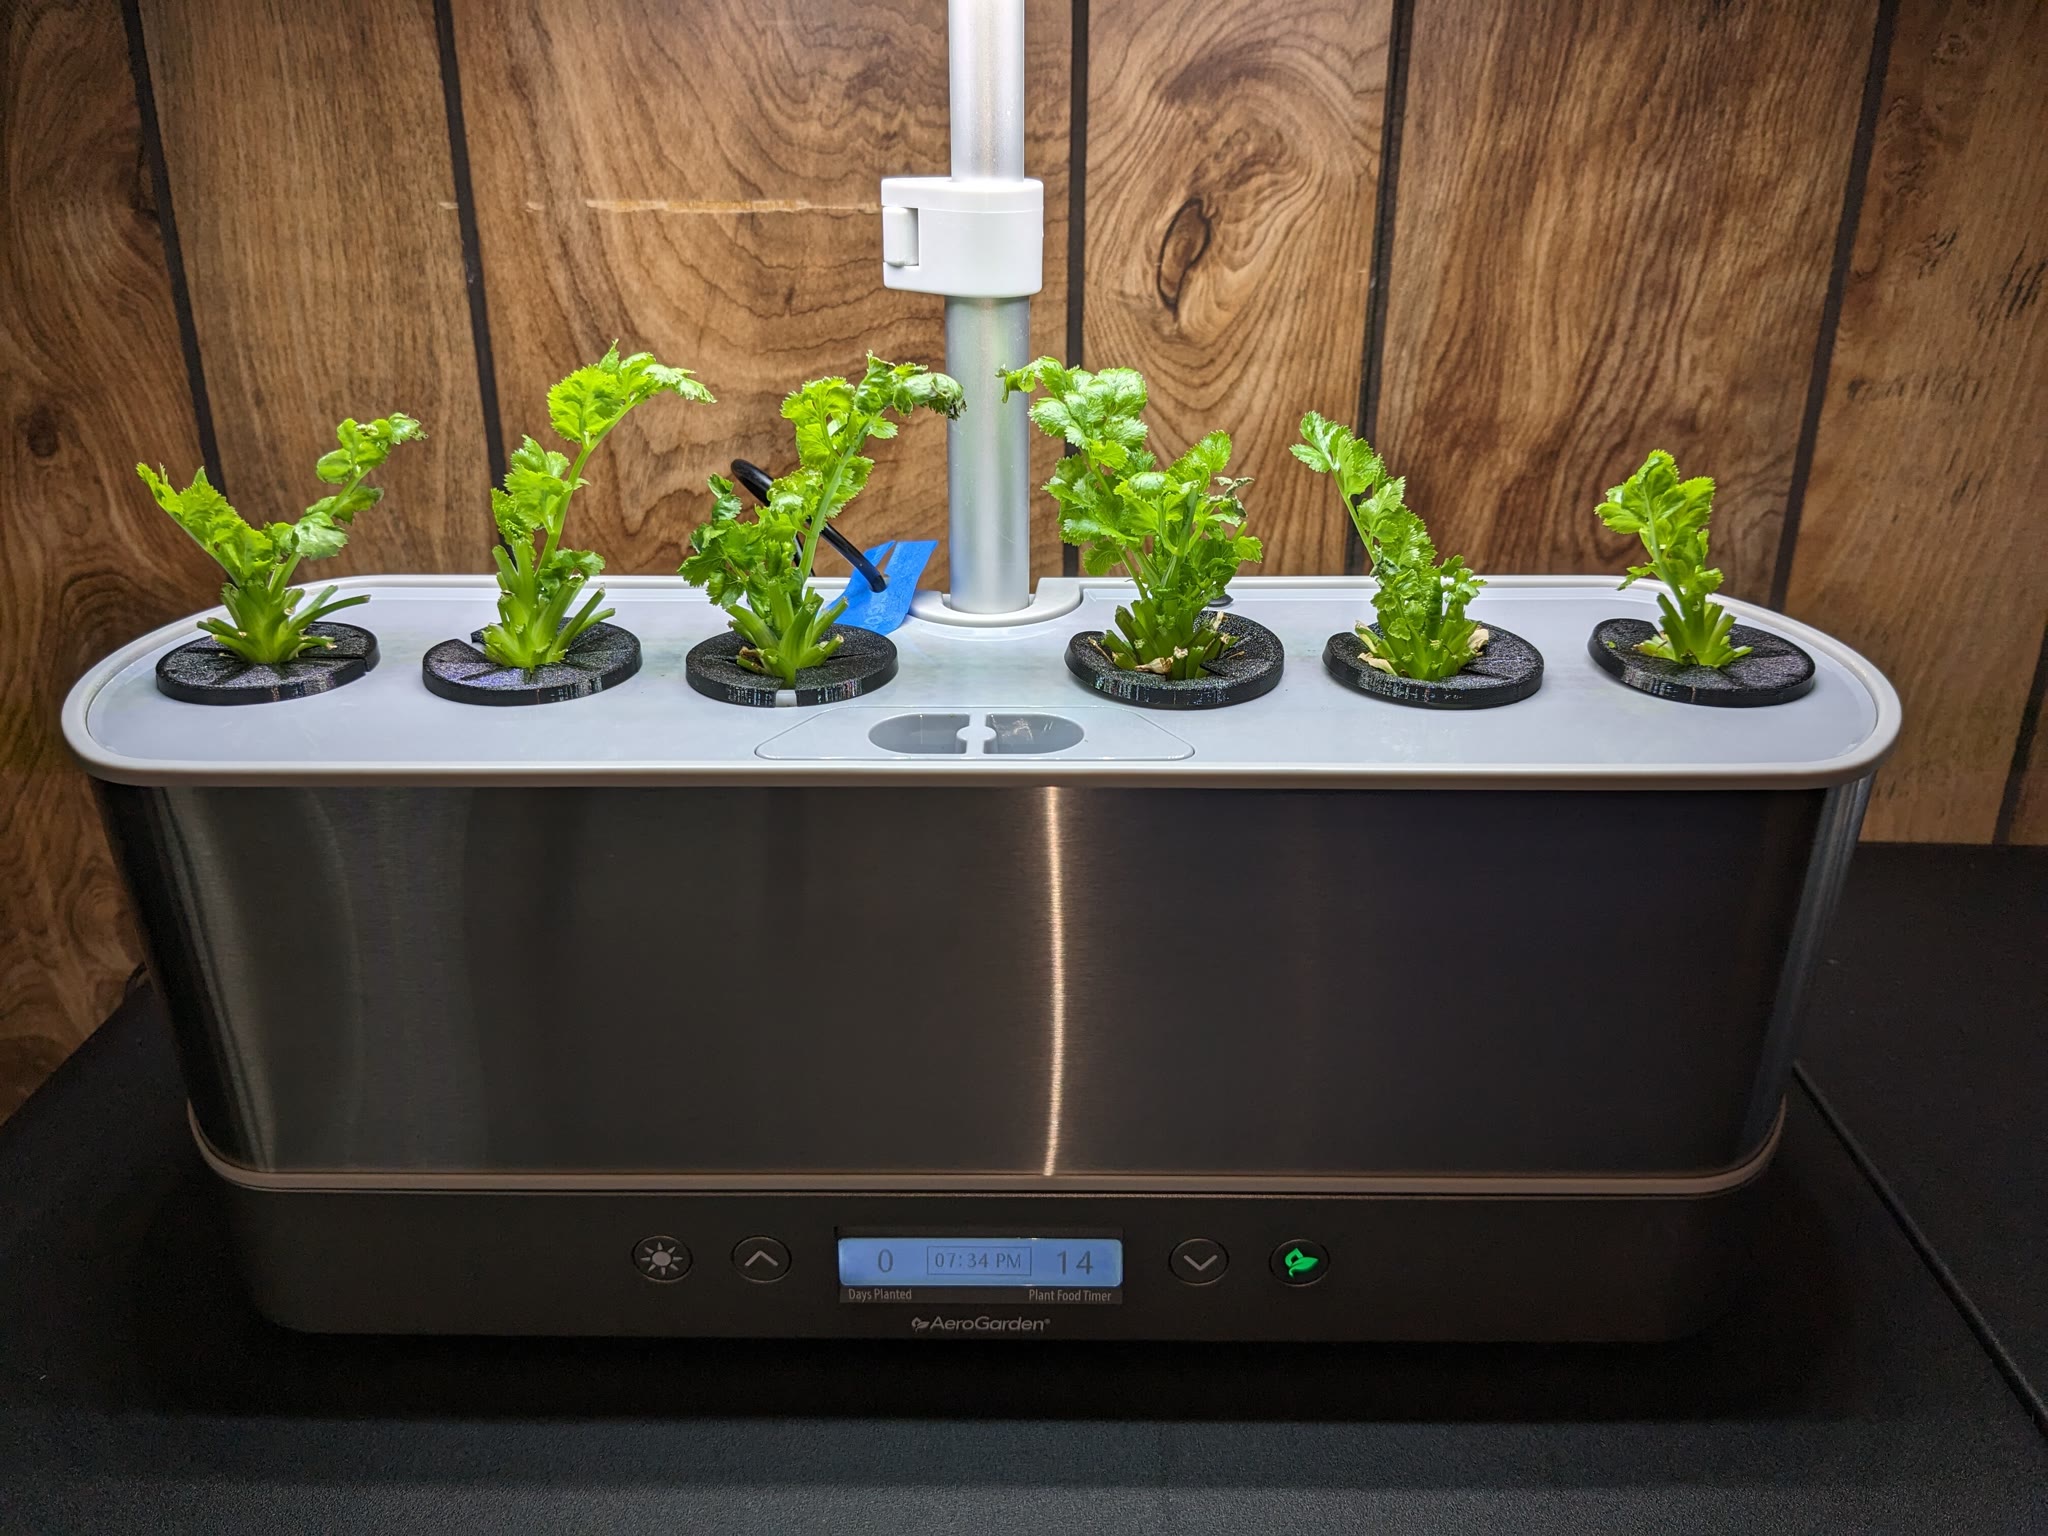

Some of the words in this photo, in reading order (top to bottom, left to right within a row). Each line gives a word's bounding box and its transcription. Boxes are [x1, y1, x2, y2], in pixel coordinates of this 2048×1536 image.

[878, 1249, 894, 1273] 0
[935, 1253, 989, 1269] 07:34
[996, 1253, 1022, 1269] PM
[1057, 1250, 1094, 1275] 14
[848, 1289, 872, 1301] Days
[874, 1289, 912, 1300] Planted
[1029, 1289, 1054, 1301] Plant
[1057, 1289, 1081, 1301] Food
[1083, 1290, 1112, 1302] Timer
